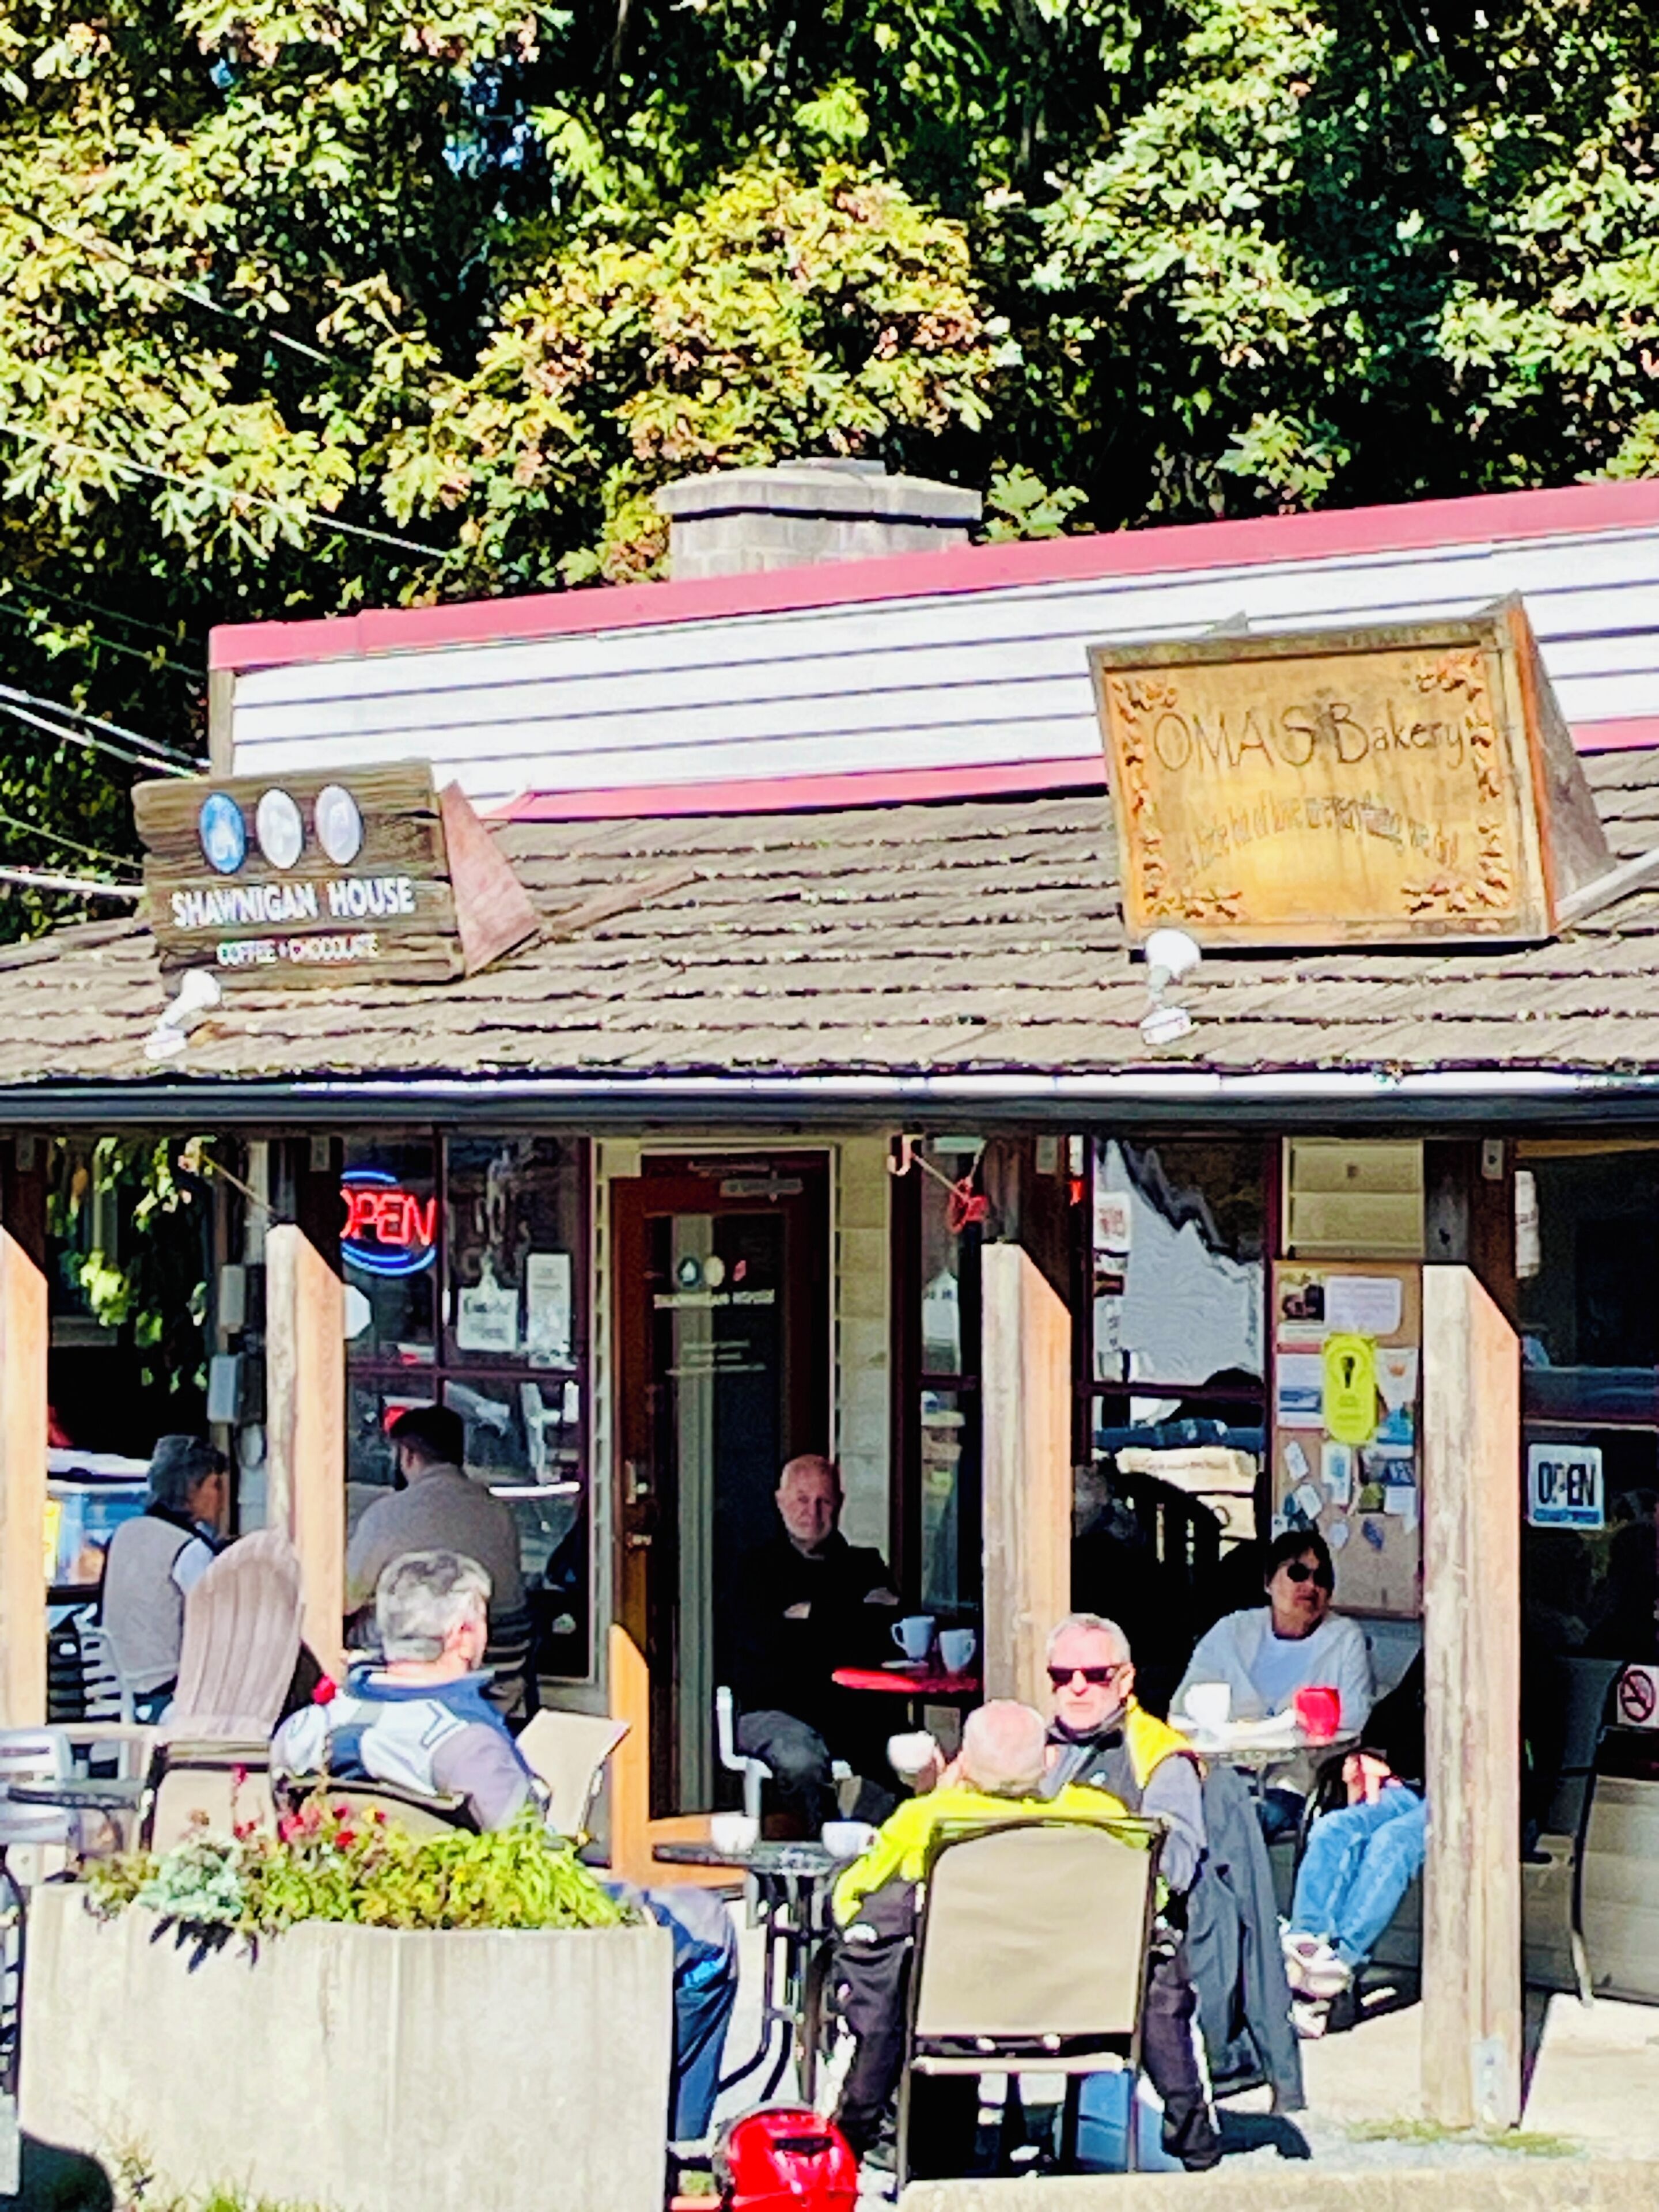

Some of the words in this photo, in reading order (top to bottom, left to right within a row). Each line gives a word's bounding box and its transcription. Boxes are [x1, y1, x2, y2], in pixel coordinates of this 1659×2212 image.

[1328, 698, 1465, 770] Bakery
[171, 882, 319, 929] SHAWNIGAN
[327, 877, 416, 918] HOUSE
[217, 940, 278, 966] COFFEE
